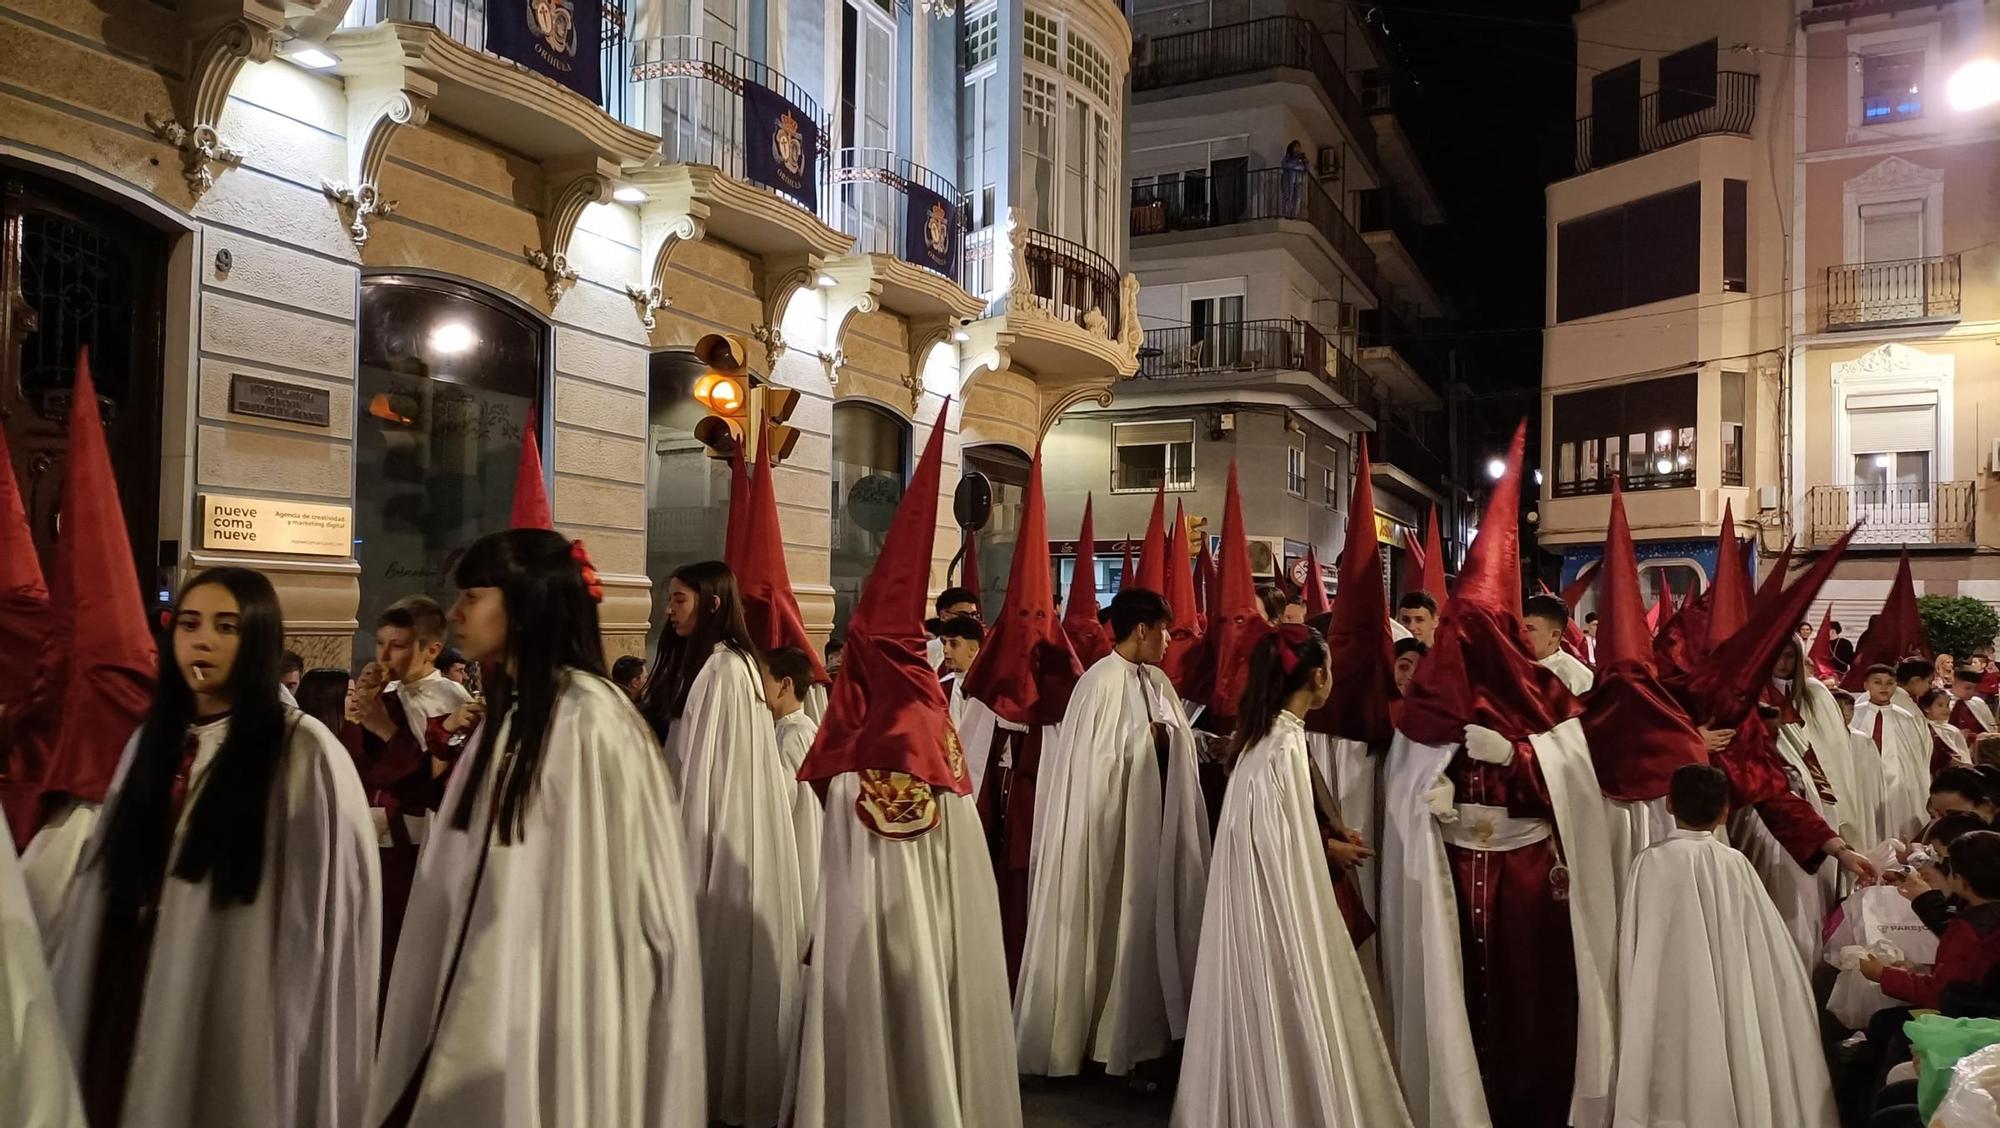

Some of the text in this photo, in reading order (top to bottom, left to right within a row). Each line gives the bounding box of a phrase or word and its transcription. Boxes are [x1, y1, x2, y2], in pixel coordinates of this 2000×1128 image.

[215, 247, 232, 272] 9
[214, 504, 257, 518] nueve
[275, 511, 301, 519] Agencia
[311, 514, 344, 522] creatividad
[213, 516, 253, 529] coma
[292, 520, 325, 528] marketing
[326, 521, 345, 529] digital
[213, 529, 257, 541] nueve
